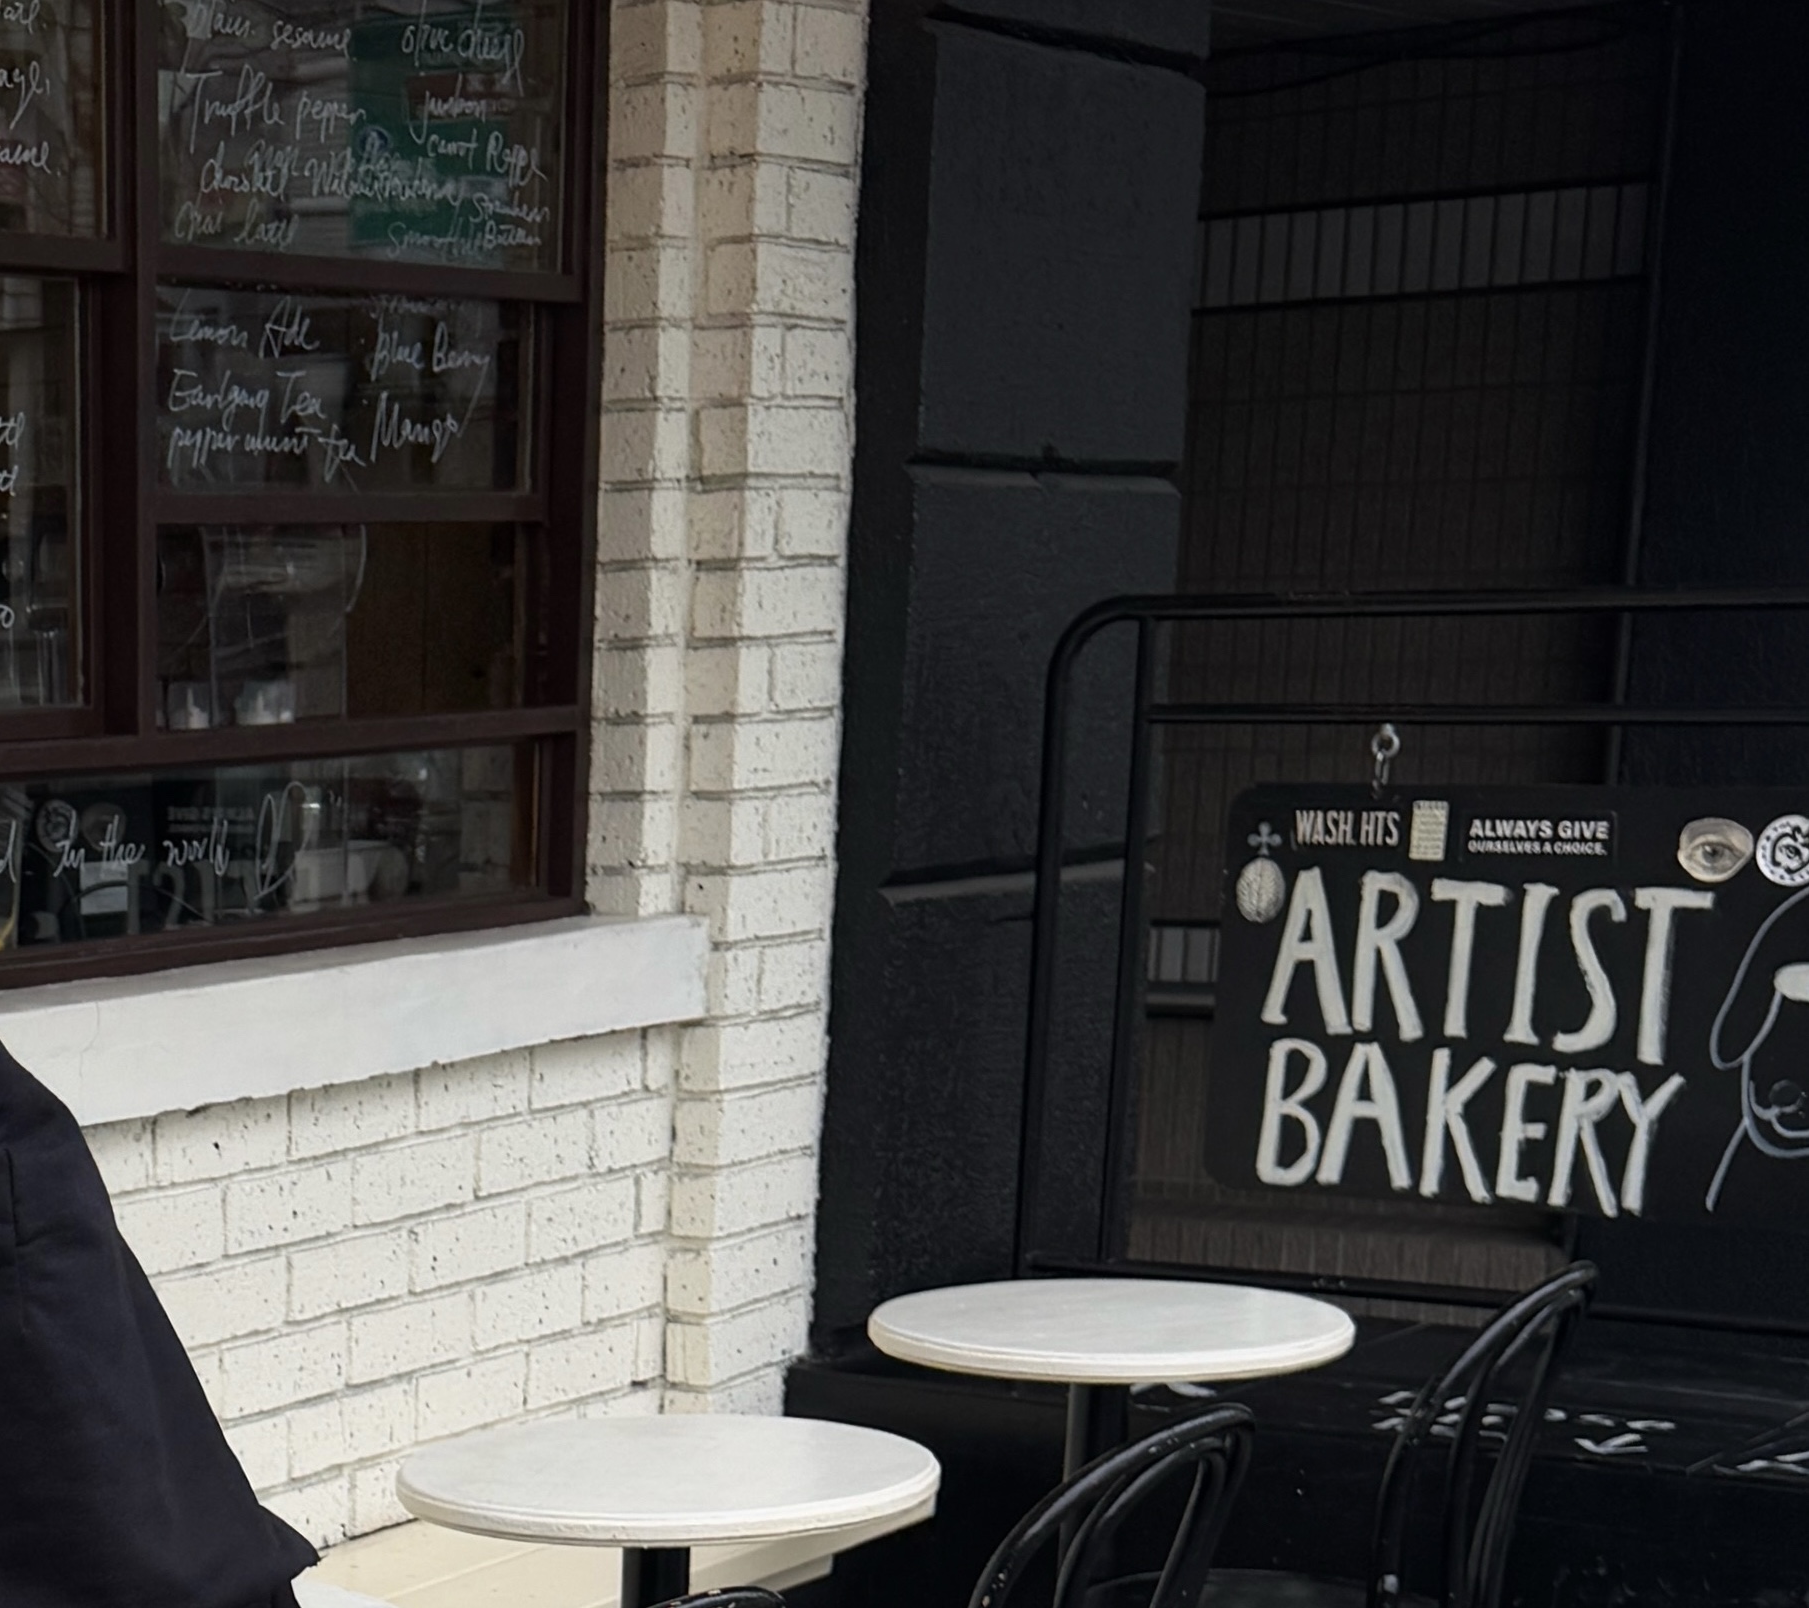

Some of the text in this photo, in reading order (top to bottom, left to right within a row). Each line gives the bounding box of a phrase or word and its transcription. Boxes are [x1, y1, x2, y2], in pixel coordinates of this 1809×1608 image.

[1468, 818, 1610, 840] ALWAYS GIVE
[1260, 866, 1716, 1065] ARTIST
[1255, 1037, 1687, 1218] BAKERY
